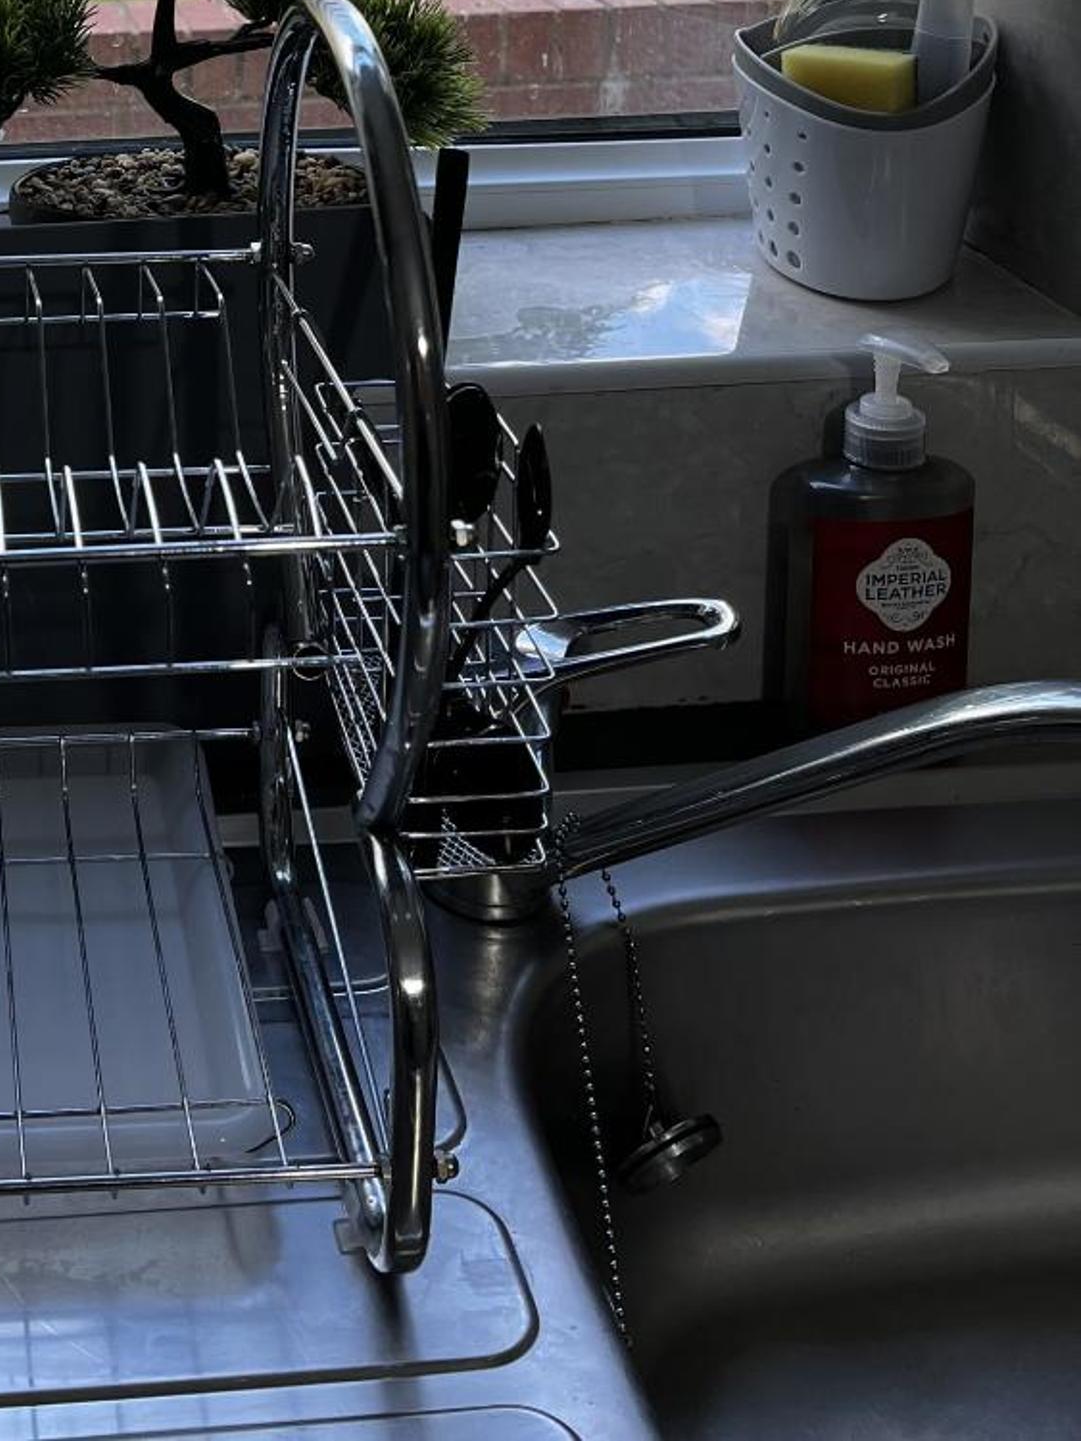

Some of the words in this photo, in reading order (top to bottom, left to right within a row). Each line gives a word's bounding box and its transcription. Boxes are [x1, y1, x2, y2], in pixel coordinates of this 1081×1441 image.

[865, 567, 946, 587] IMPERIAL
[865, 582, 946, 601] LEATHER
[843, 640, 900, 656] HAND
[906, 632, 956, 654] WASH
[867, 660, 937, 677] ORIGINAL
[872, 673, 932, 689] CLASSIC
